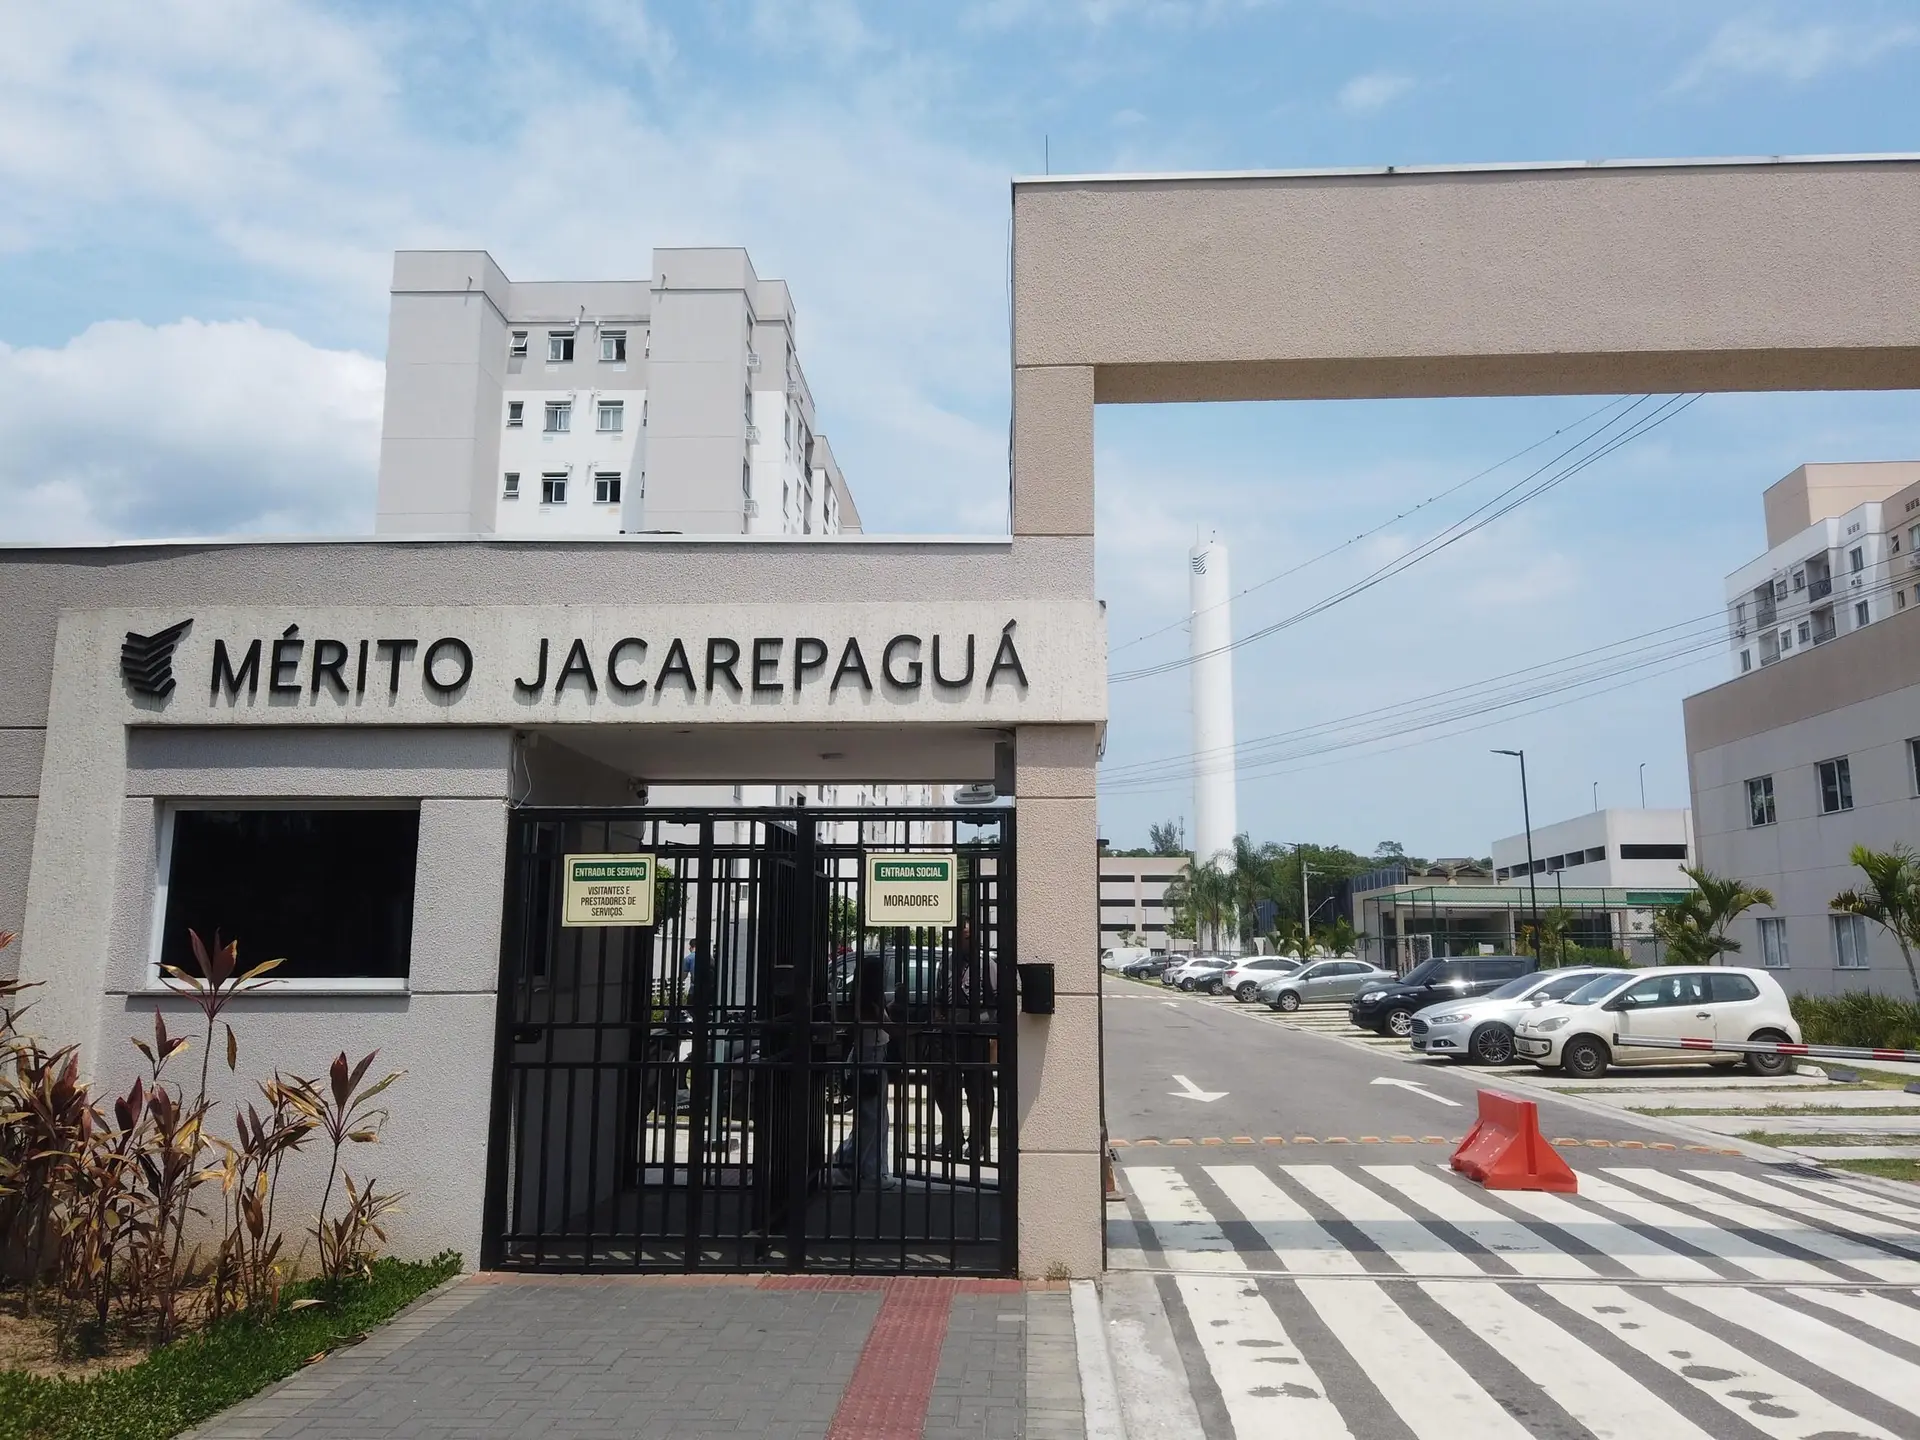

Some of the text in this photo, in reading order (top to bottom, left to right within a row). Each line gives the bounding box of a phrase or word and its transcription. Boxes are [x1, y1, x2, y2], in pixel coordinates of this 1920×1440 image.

[211, 618, 1029, 698] MÉRITO JACAREPAGUÁ
[575, 867, 645, 878] ENTRADA DE SERVIÇO
[880, 866, 943, 877] ENTRADA SOCIAL
[587, 886, 630, 895] VISITANTES E
[580, 896, 637, 906] PRESTADORES DE
[883, 894, 939, 907] MORADORES
